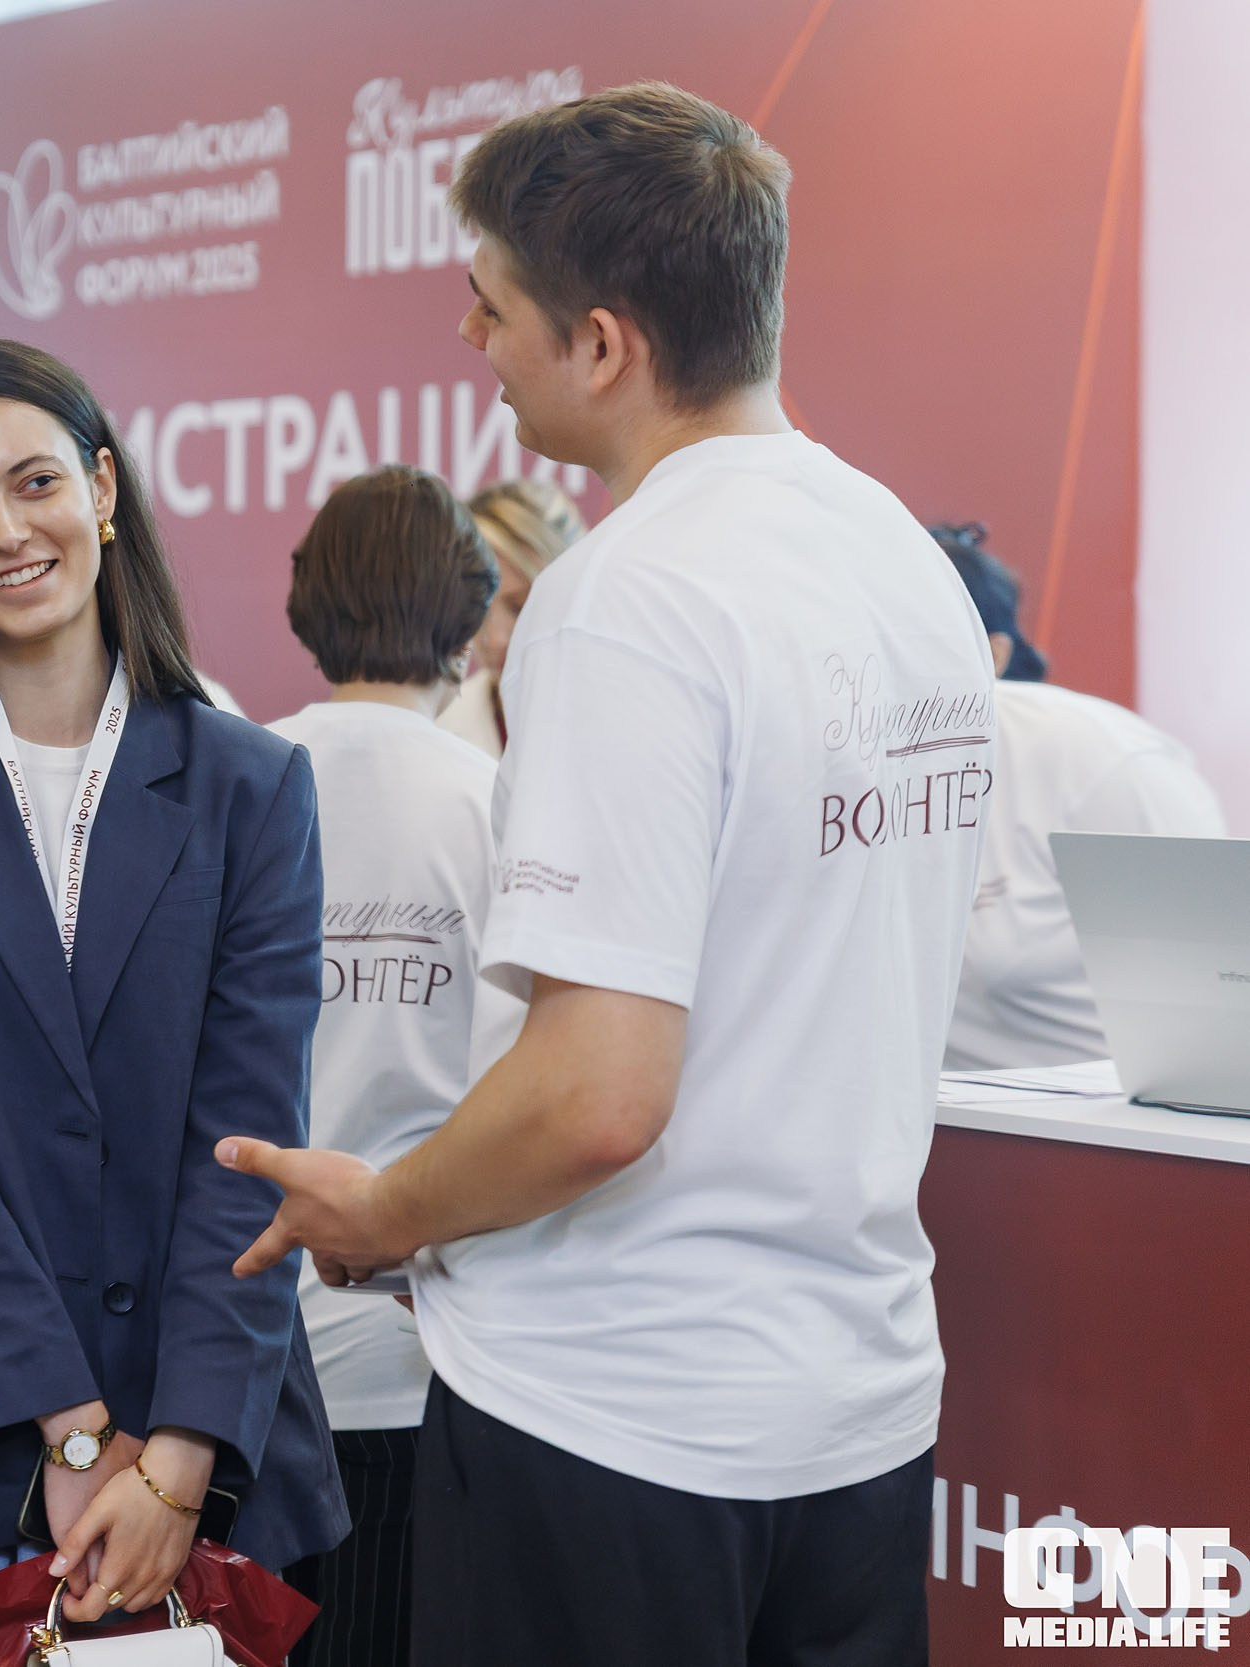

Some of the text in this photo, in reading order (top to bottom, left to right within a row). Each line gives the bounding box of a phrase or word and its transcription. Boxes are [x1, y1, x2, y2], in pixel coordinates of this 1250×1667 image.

[77, 104, 291, 192] БАЛТИЙСКИЙ
[76, 169, 281, 246] КУЛЬТУРНЫЙ
[75, 240, 260, 307] ФОРУМ 2025
[64, 823, 87, 919] КУЛЬТУРНЫЙ
[77, 769, 102, 821] ФОРУМ
[105, 706, 122, 734] 2025
[322, 954, 453, 1006] ОНТЁР
